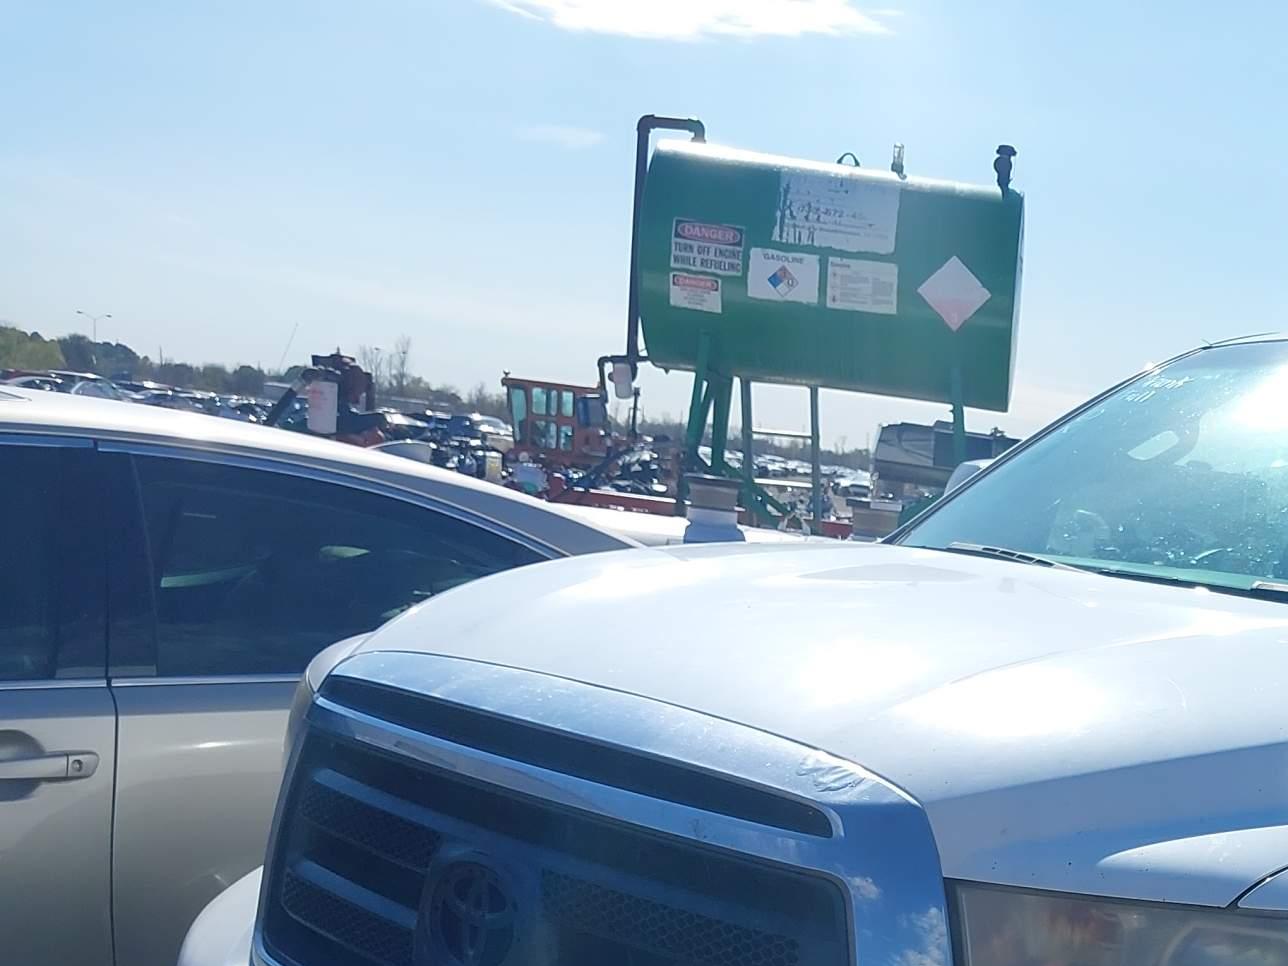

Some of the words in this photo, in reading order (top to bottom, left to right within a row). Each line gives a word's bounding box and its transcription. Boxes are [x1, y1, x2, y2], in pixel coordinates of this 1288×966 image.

[684, 224, 735, 241] DANGER
[674, 242, 694, 254] TURN
[697, 245, 711, 256] OFF
[714, 247, 741, 260] ENGINE
[763, 253, 804, 264] GASOLINE
[673, 254, 697, 267] WHILE
[700, 258, 742, 272] REFUELING
